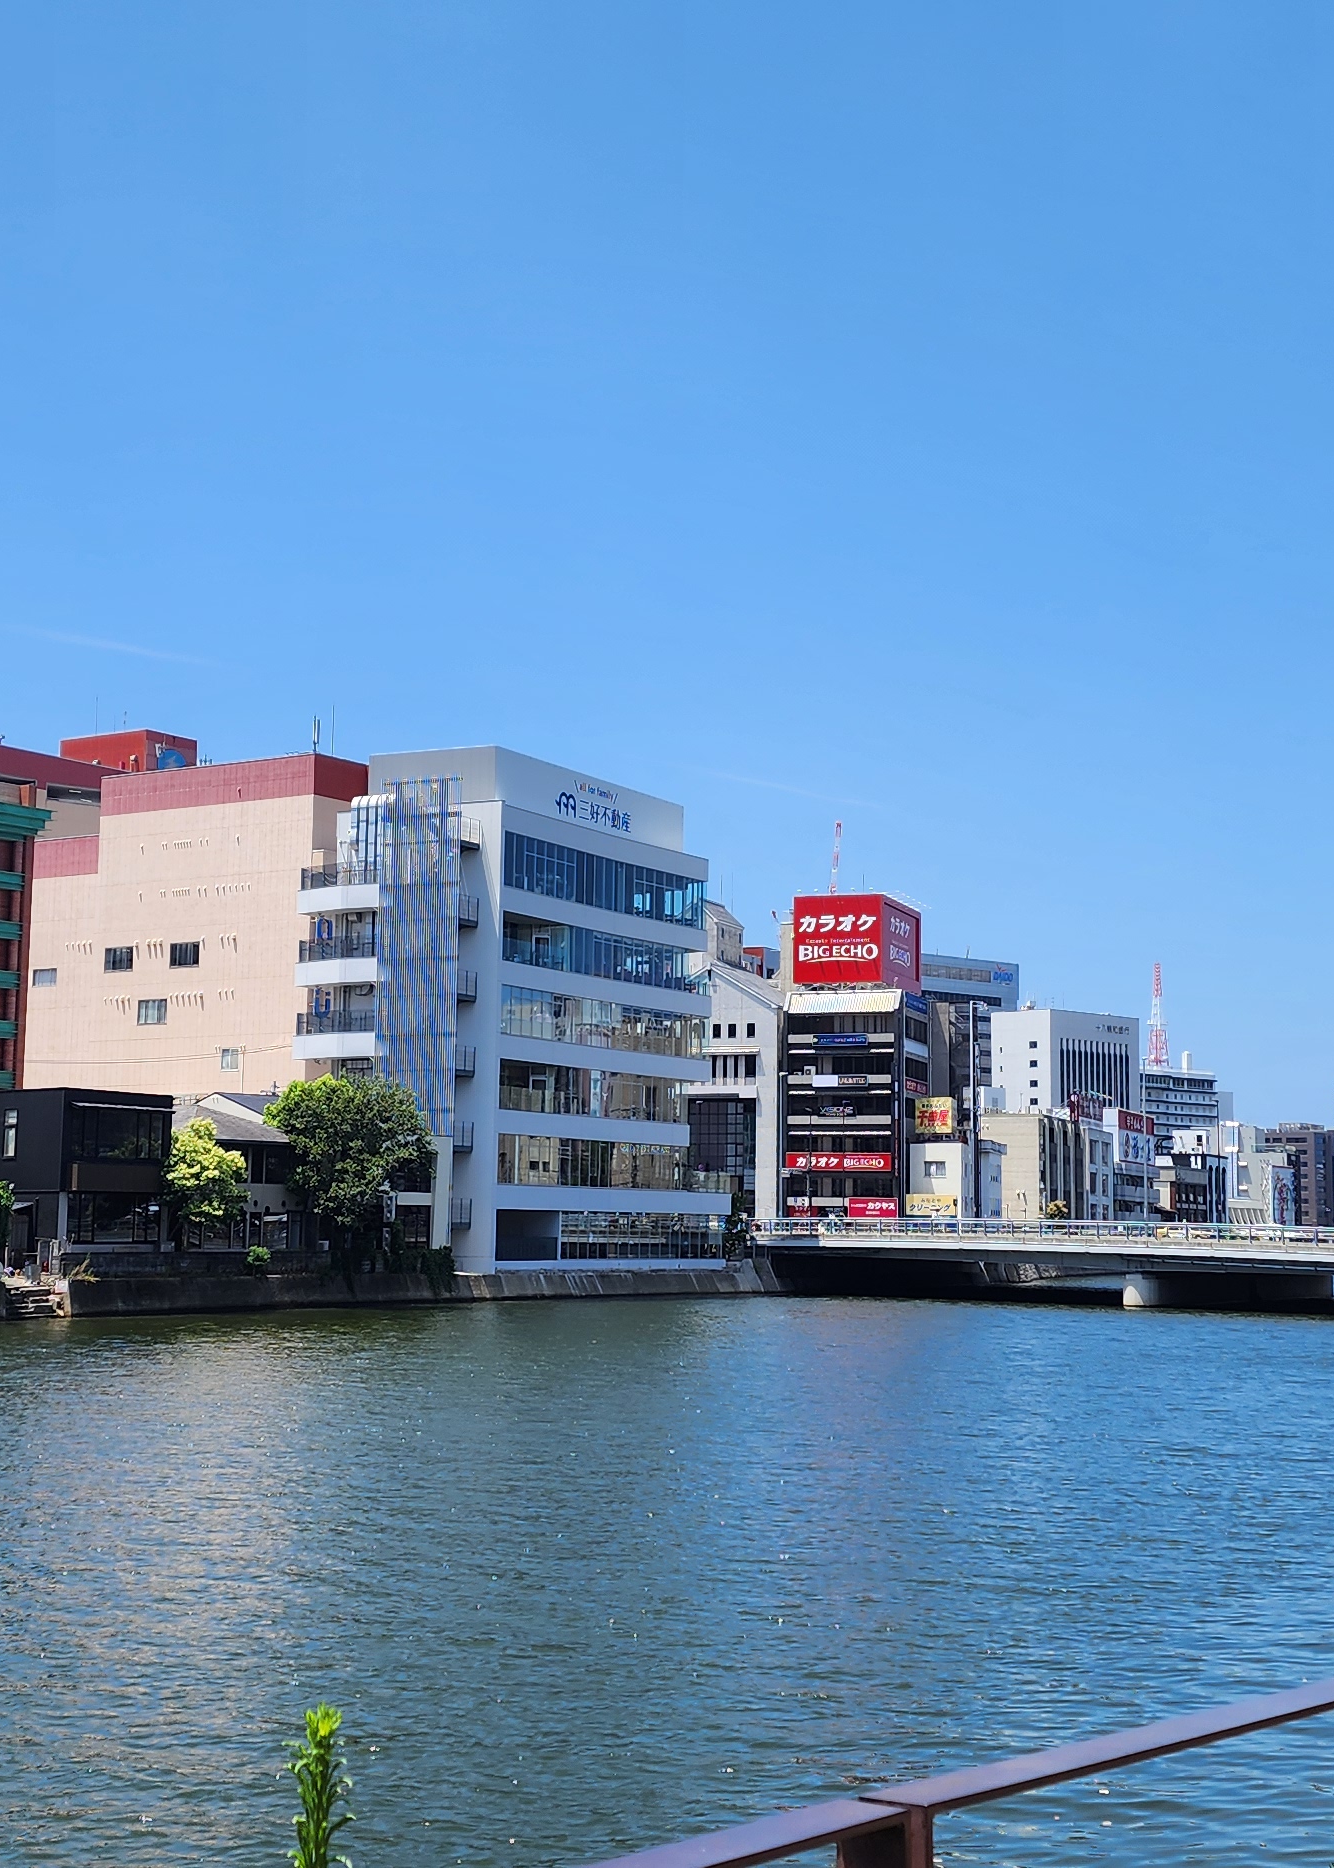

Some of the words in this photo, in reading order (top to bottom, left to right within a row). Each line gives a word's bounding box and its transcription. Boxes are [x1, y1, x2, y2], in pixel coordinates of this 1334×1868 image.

[579, 800, 631, 833] 三好不動産
[798, 914, 877, 932] カラオケ
[889, 915, 910, 938] カラオケ
[798, 945, 830, 961] BIG
[832, 943, 879, 960] ECHO
[795, 1157, 839, 1167] カラオケ
[843, 1158, 859, 1168] BIG
[909, 1203, 951, 1212] クリーニング
